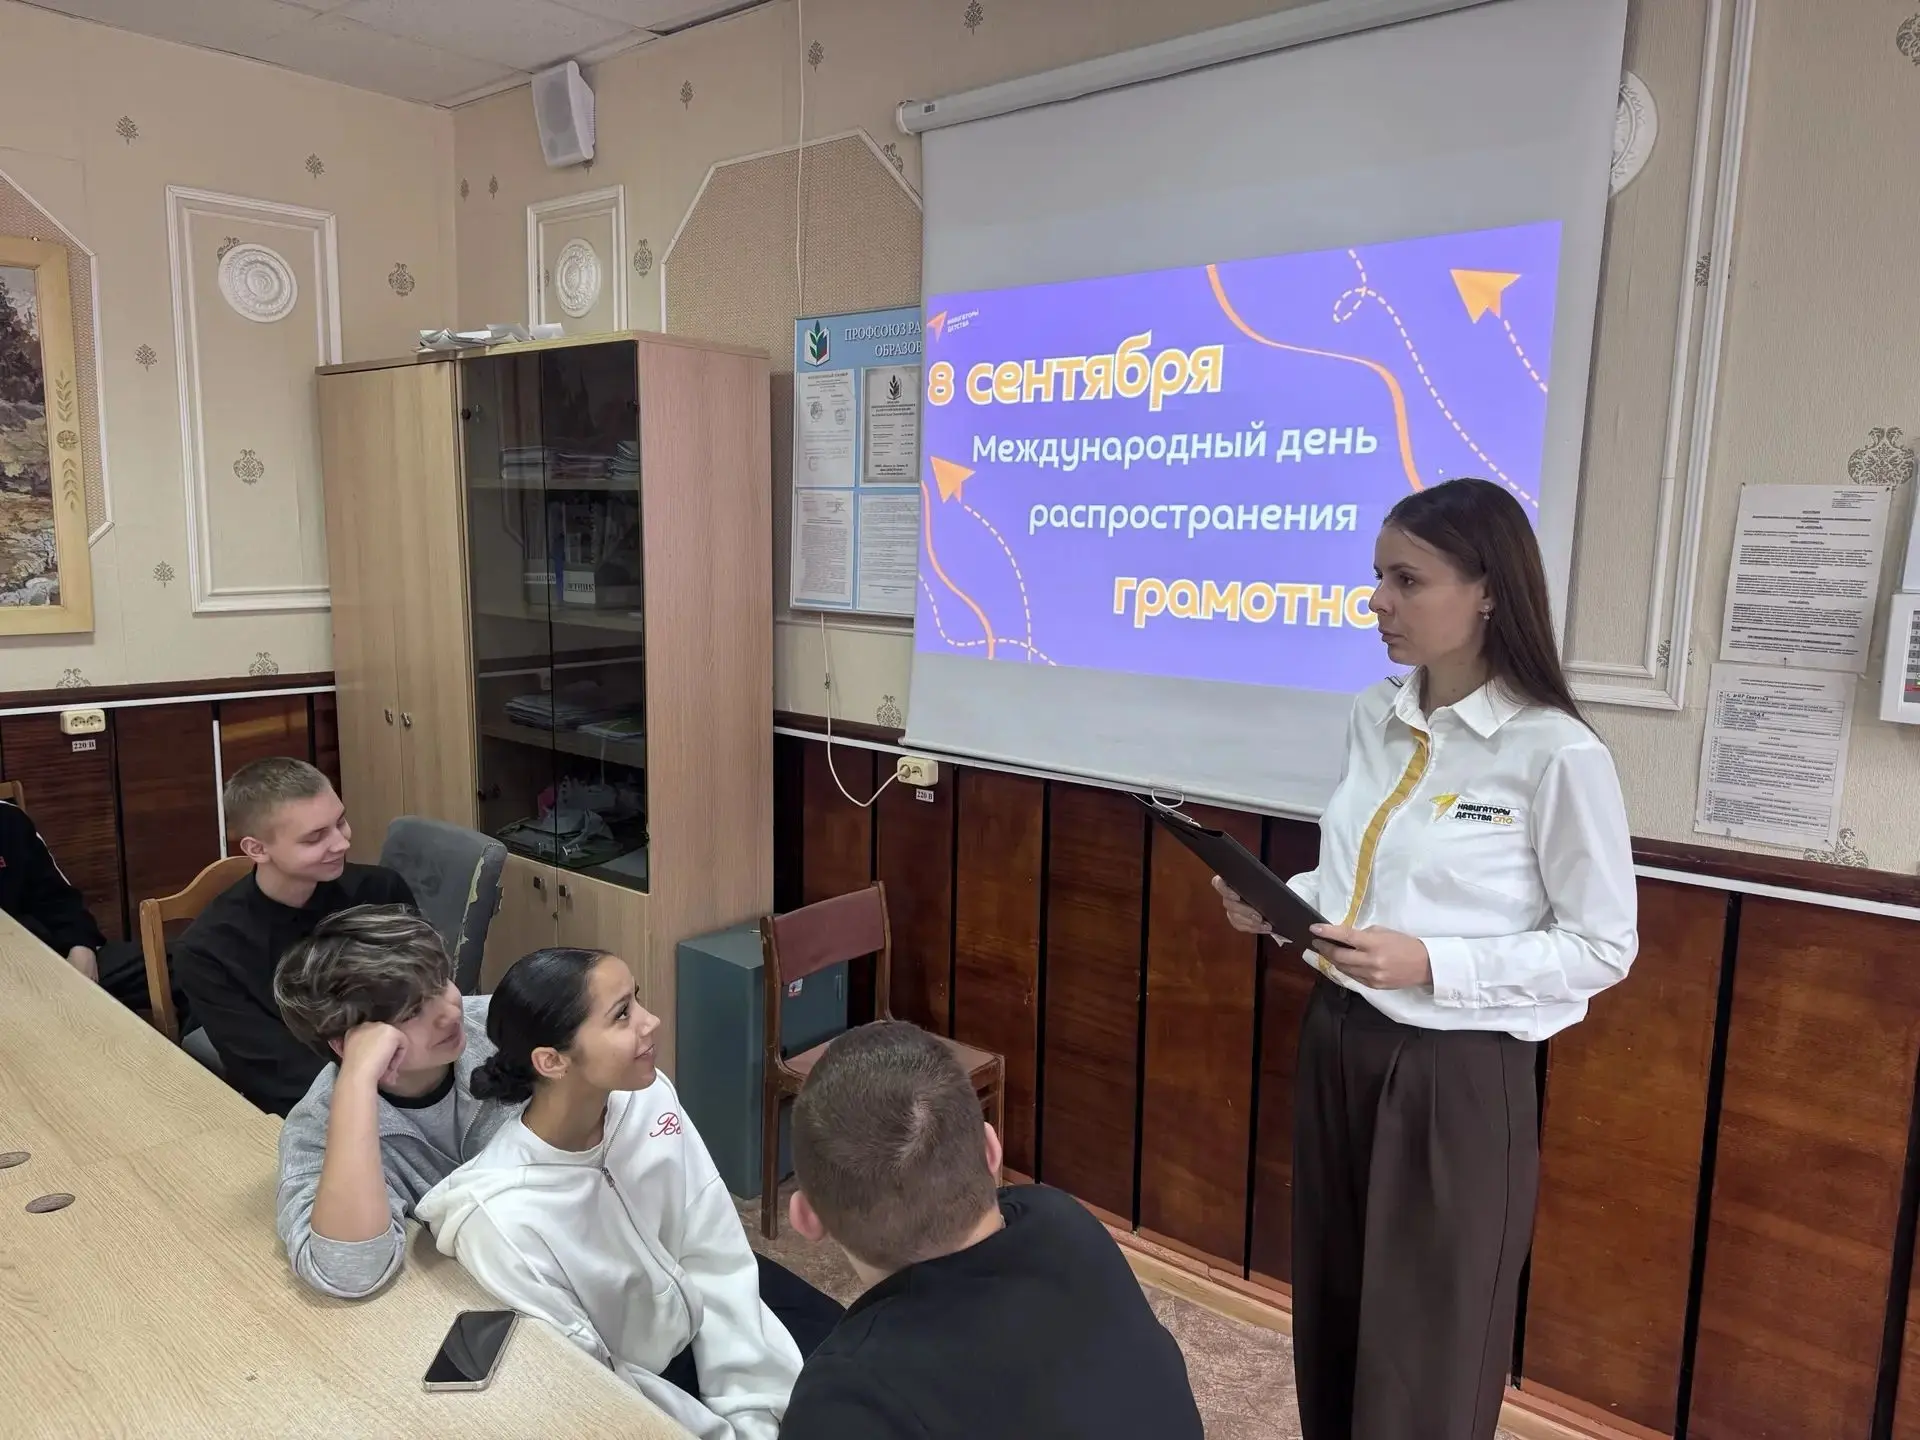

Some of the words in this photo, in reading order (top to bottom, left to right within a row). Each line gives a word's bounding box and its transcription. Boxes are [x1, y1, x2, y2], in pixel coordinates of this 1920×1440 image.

[844, 322, 906, 341] ПРОФСОЮЗ
[927, 361, 955, 406] 8
[966, 330, 1224, 411] сентября
[972, 421, 1268, 471] Международный
[1276, 425, 1378, 459] день
[1028, 501, 1358, 538] распространения
[74, 742, 87, 750] 220
[917, 791, 928, 799] 220
[1455, 812, 1492, 821] ДЕТСТВА
[1457, 803, 1511, 816] НАВИГАТОРЫ
